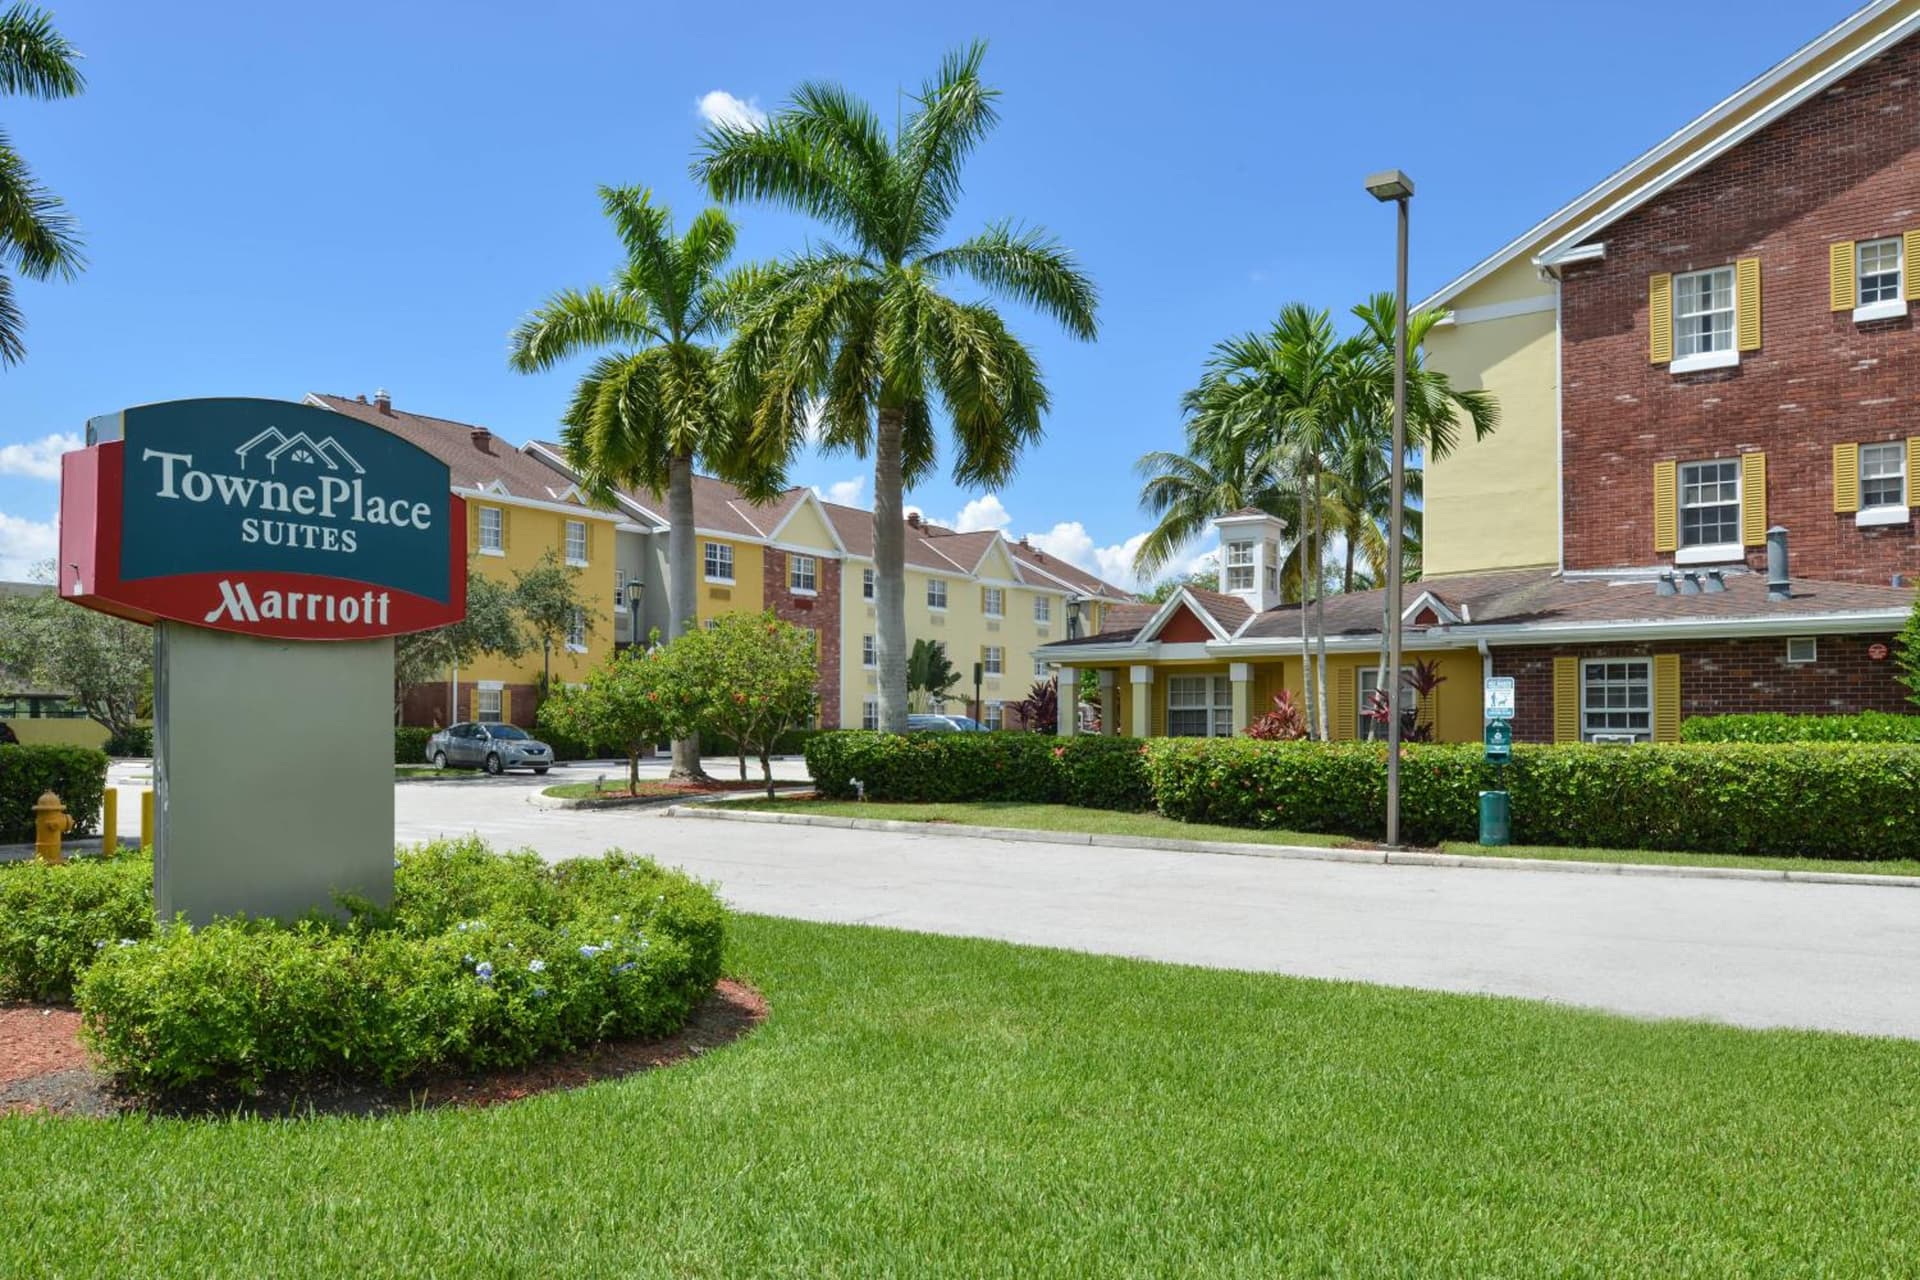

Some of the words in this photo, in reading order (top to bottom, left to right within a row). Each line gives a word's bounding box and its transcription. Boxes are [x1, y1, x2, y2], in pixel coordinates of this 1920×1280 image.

[143, 448, 431, 530] TownePlace
[242, 518, 358, 553] SUITES
[204, 580, 391, 626] Marriott
